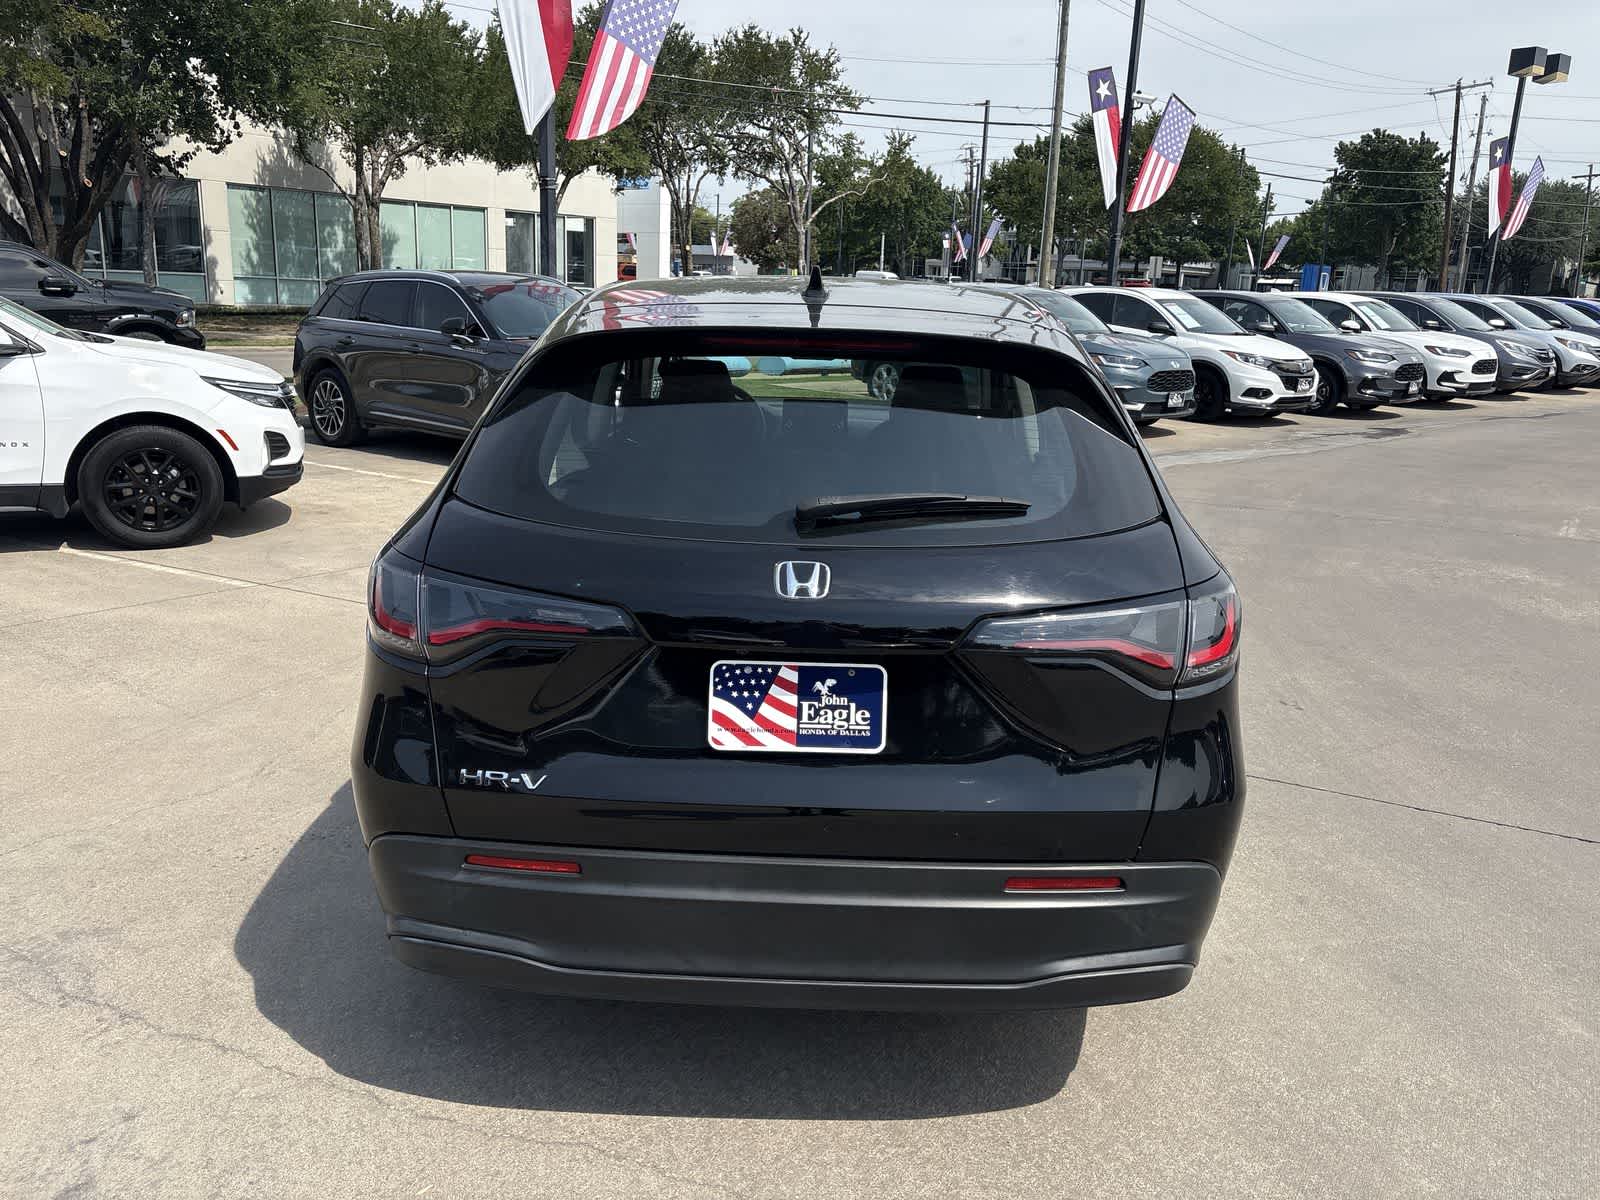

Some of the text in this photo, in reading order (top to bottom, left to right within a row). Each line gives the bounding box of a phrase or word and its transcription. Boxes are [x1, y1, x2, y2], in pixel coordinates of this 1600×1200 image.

[818, 694, 848, 707] John
[800, 701, 871, 730] Eagle
[460, 768, 548, 791] HR-V
